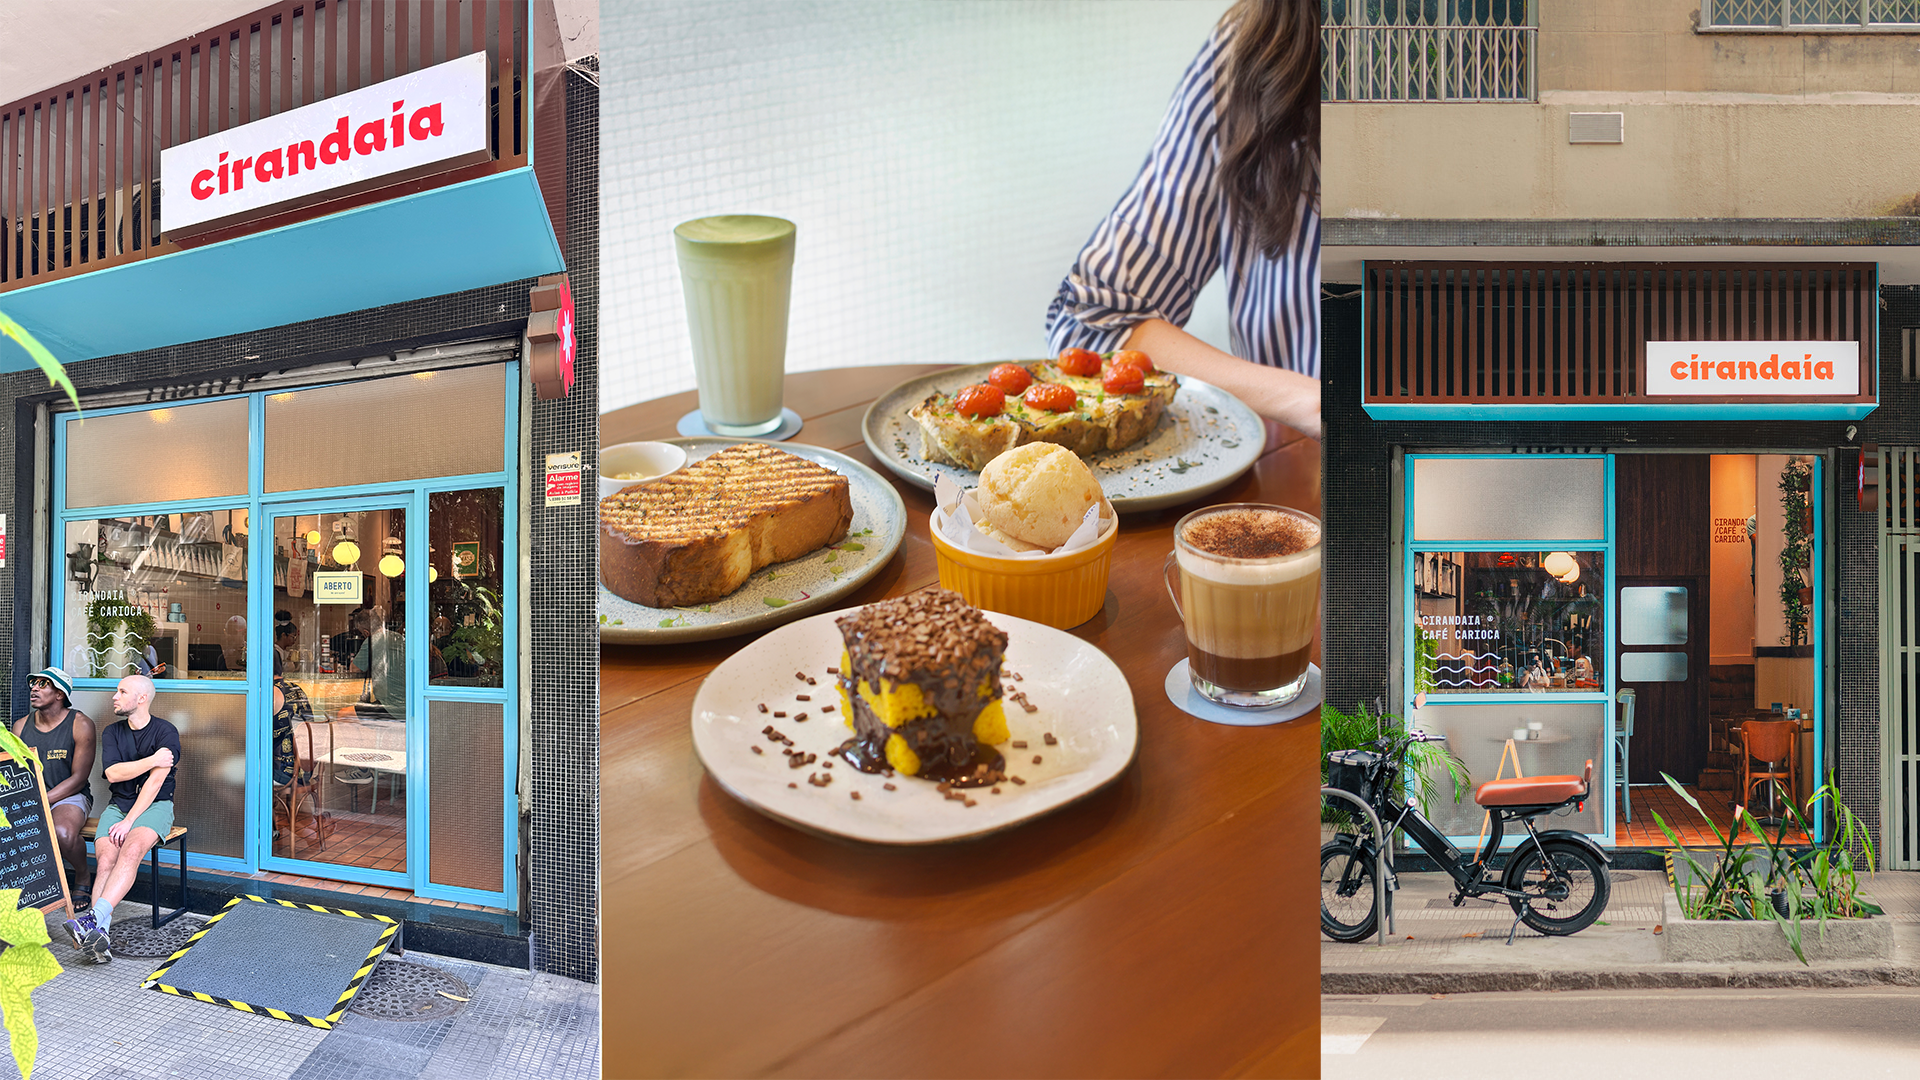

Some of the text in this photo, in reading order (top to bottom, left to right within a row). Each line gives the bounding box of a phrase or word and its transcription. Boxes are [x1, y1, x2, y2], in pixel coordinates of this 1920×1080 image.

[190, 99, 445, 201] cirandaia
[1670, 353, 1835, 380] cirandaia
[548, 474, 579, 482] Alarme
[1715, 518, 1748, 527] CIRANDAI
[1715, 535, 1745, 543] CARIOCA
[324, 581, 352, 591] ABERTO
[71, 589, 124, 602] CIRANDAIA
[71, 604, 142, 617] CAFÉ CARIOCA
[1422, 615, 1481, 626] CIRANDAIA
[1422, 627, 1500, 640] CAFÉ CARIOCA
[20, 859, 29, 868] de
[31, 855, 47, 864] coco
[10, 869, 46, 890] brigadeiro
[38, 881, 60, 898] mais!
